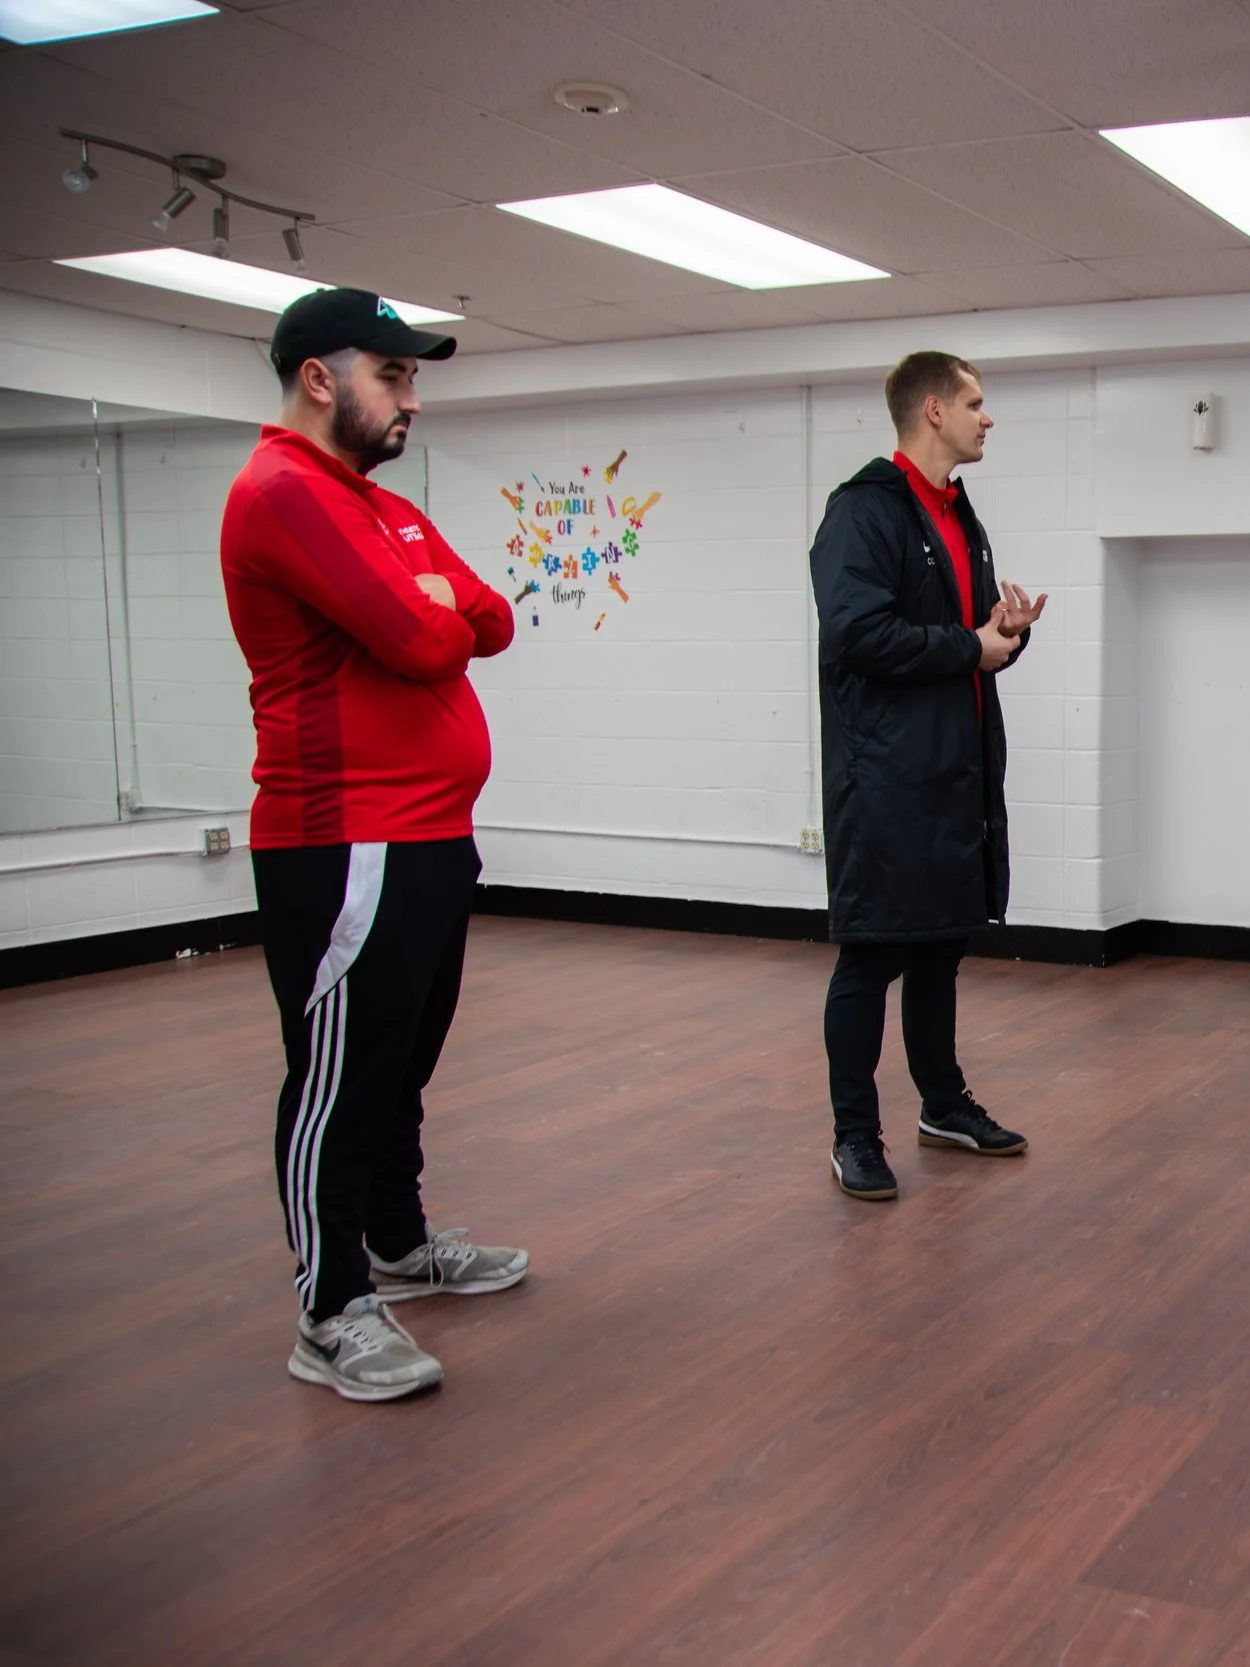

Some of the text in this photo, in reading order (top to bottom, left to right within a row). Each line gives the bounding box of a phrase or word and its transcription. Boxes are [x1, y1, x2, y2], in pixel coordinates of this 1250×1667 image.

[548, 481, 585, 495] You Are
[535, 498, 596, 517] CAPABLE
[557, 518, 575, 535] OF
[552, 582, 586, 610] things
